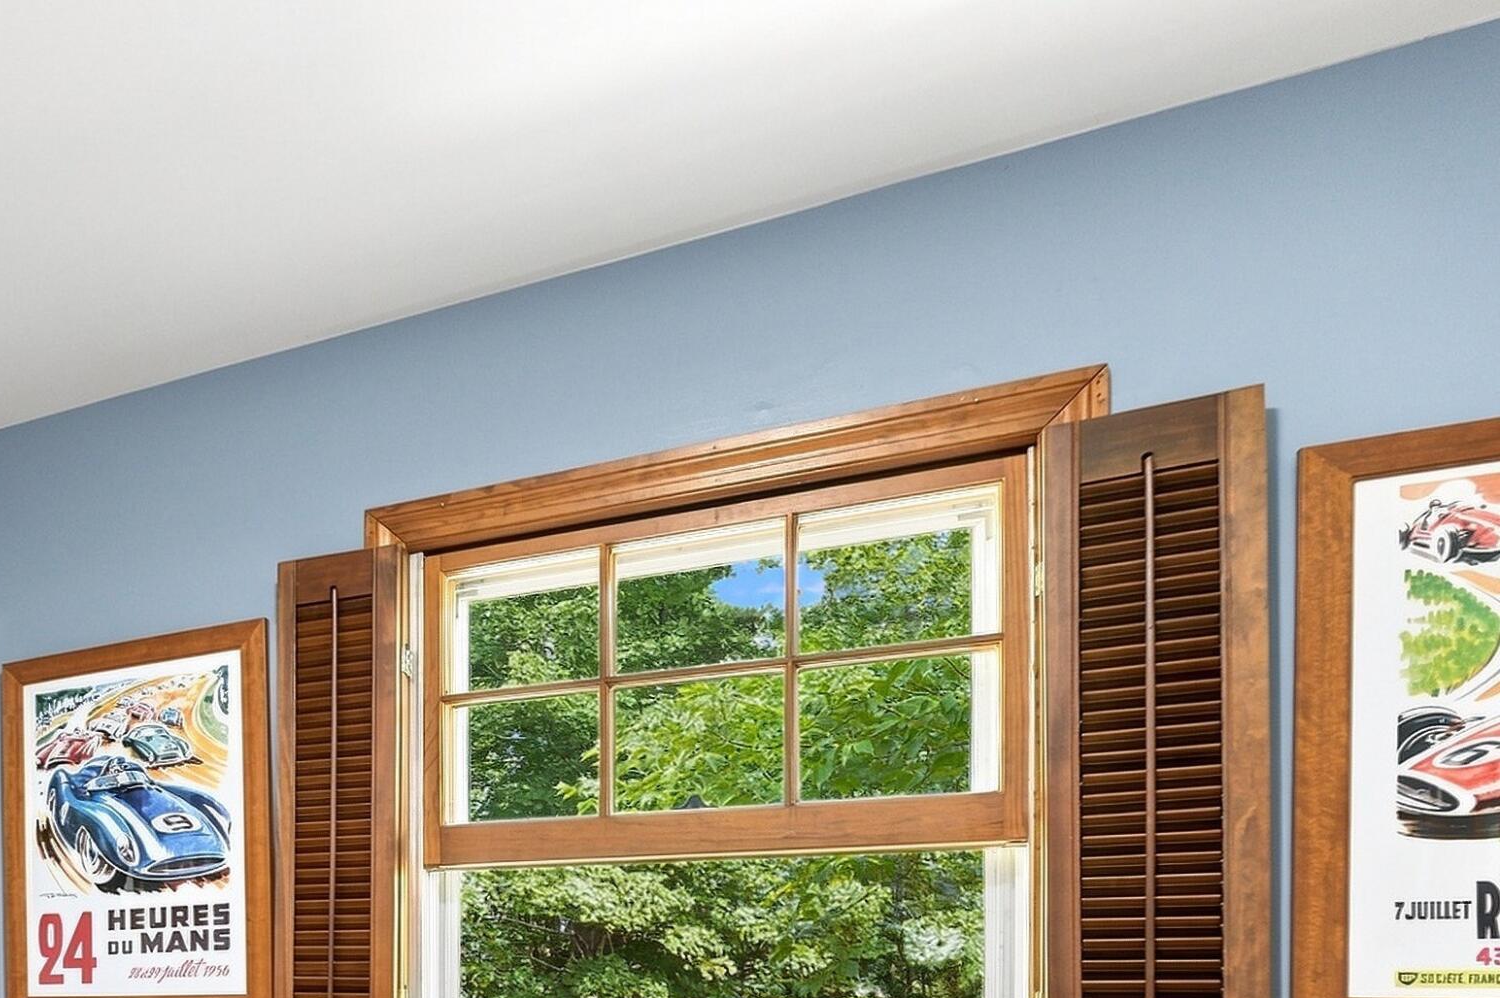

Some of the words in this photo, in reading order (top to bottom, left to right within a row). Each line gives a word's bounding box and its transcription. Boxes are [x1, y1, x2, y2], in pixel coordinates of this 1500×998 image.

[108, 902, 230, 931] HEURES
[1405, 901, 1472, 920] JUILLET
[38, 911, 97, 985] 24
[140, 928, 231, 954] MANS
[203, 964, 230, 978] 1956
